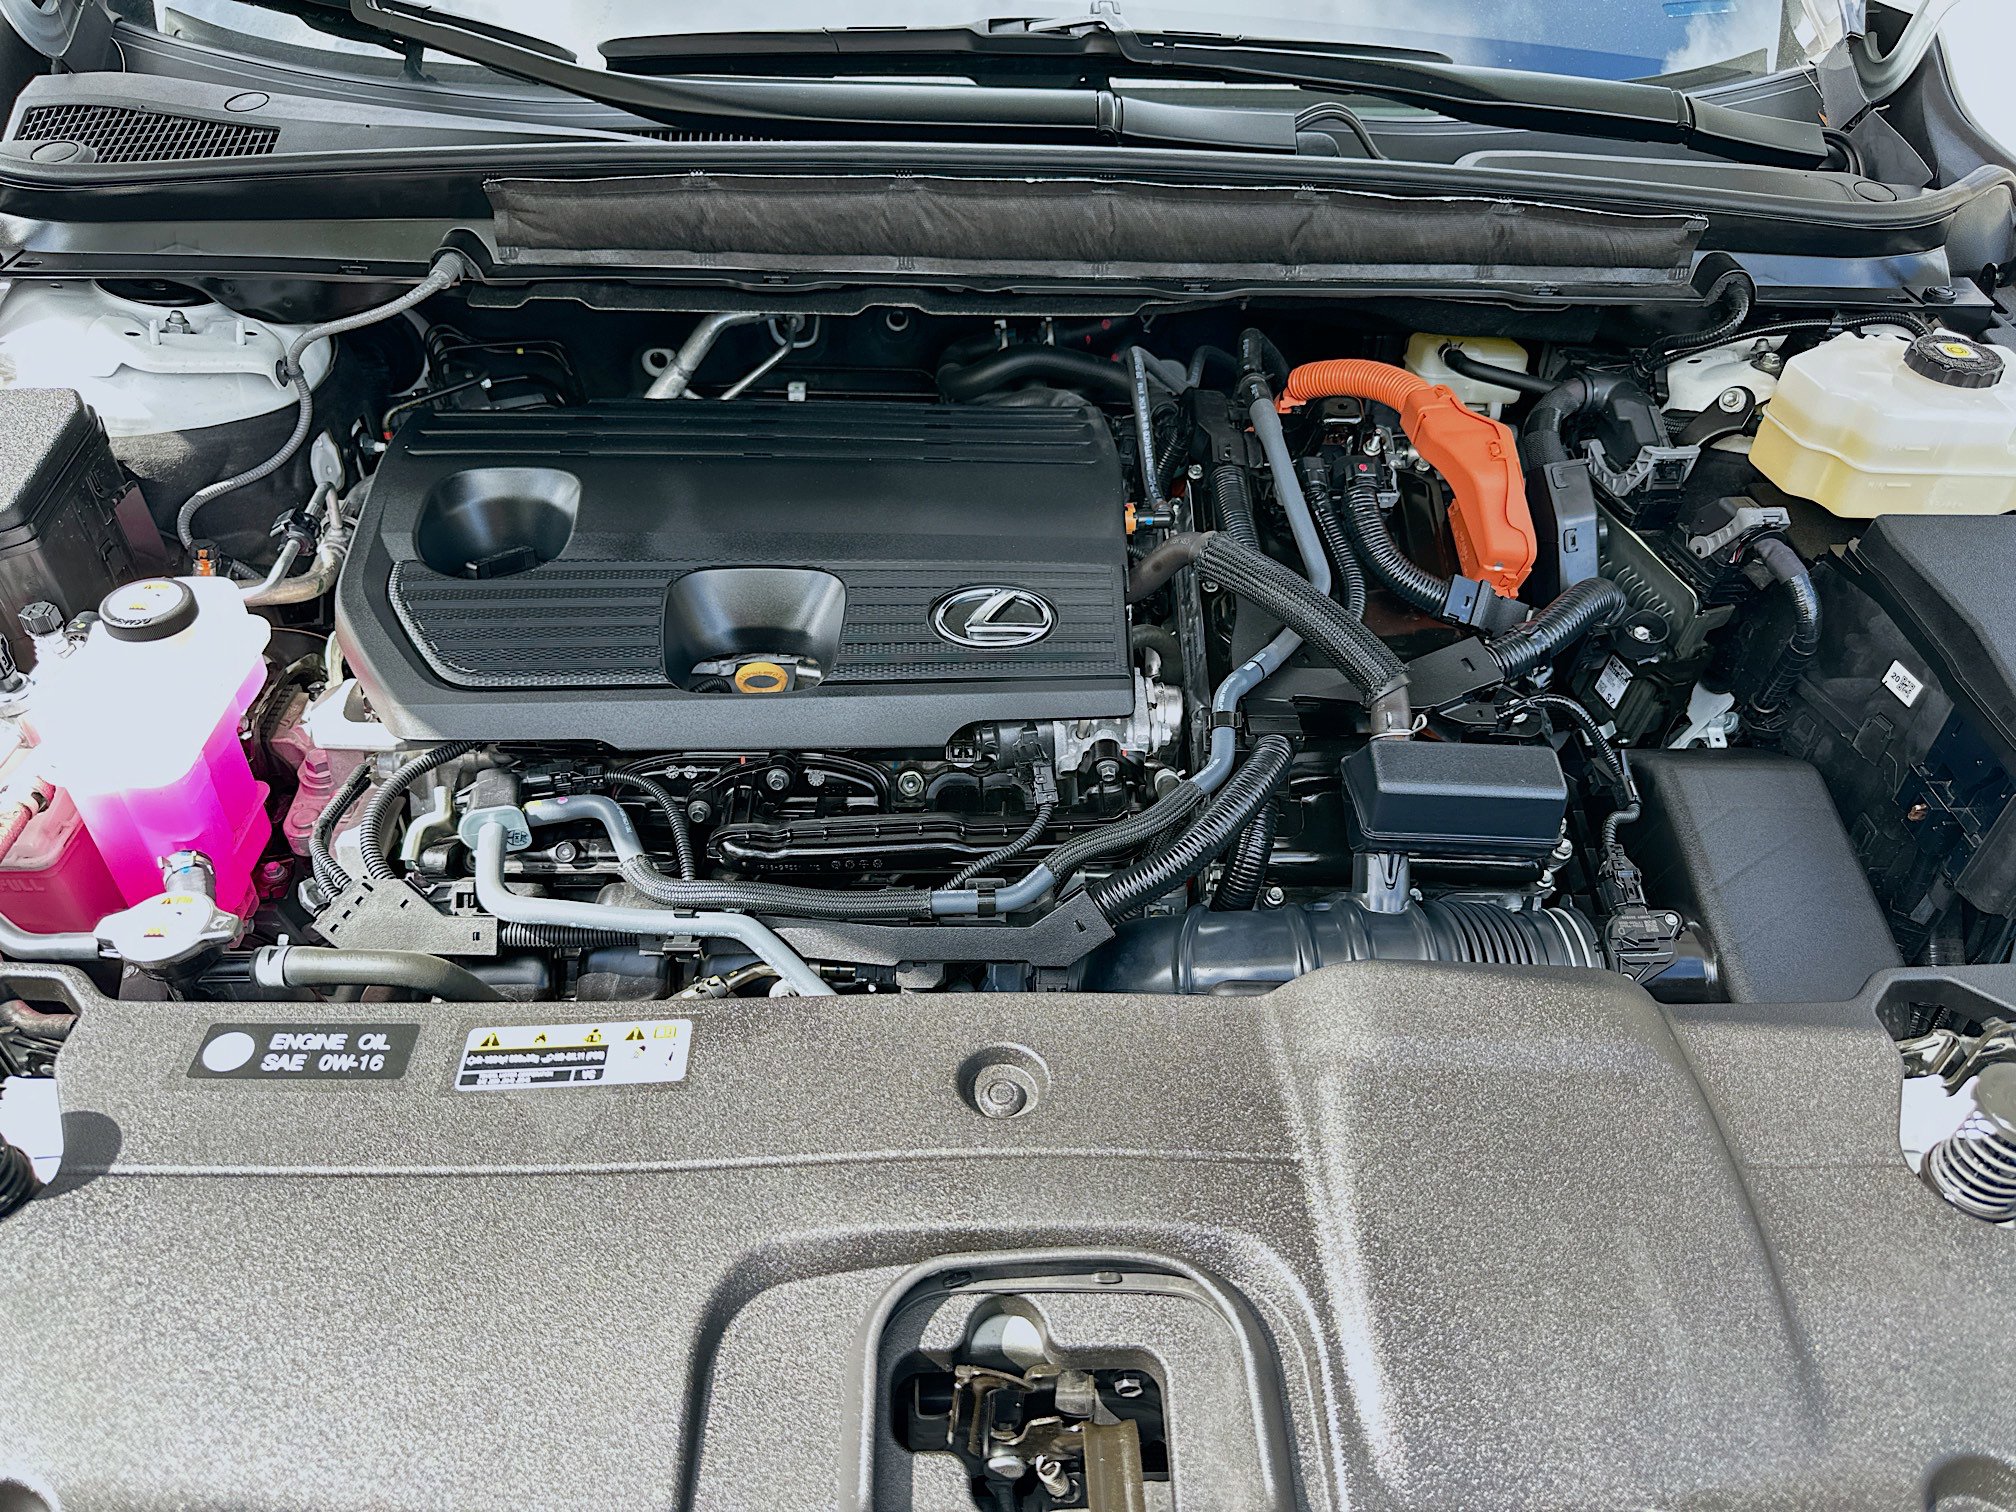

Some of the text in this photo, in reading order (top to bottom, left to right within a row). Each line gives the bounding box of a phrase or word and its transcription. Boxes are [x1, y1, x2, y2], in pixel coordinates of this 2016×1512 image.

[1890, 671, 1901, 683] 20
[268, 1033, 391, 1051] ENGINE OIL
[260, 1053, 386, 1072] SAE 0W-16
